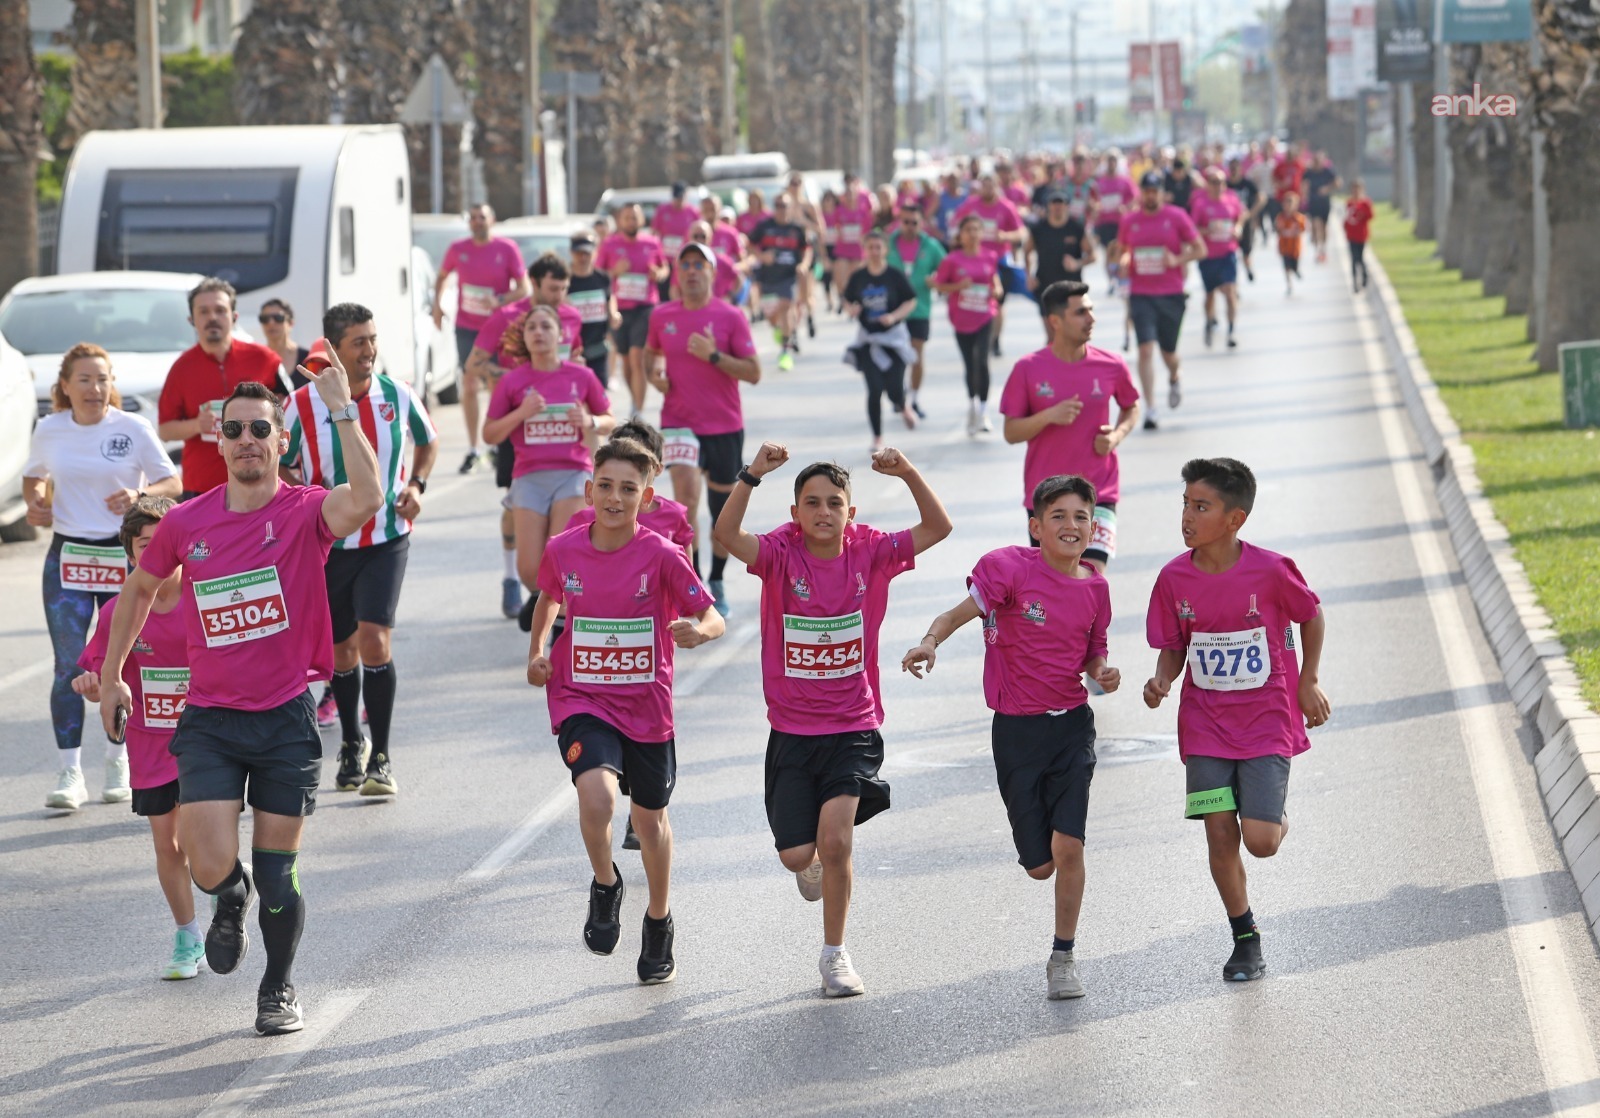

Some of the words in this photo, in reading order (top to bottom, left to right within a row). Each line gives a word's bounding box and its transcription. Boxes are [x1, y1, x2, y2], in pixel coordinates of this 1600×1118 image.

[67, 566, 122, 582] 35174
[205, 579, 240, 593] KARŞIYAKA
[239, 571, 275, 585] BELEDİYESİ
[206, 601, 280, 633] 35104
[585, 623, 618, 631] KARŞIYAKA
[618, 622, 651, 631] BELEDİYESİ
[797, 622, 830, 630] KARŞIYAKA
[830, 617, 861, 628] BELEDİYESİ
[576, 651, 650, 670] 35456
[788, 644, 861, 667] 35454
[1196, 645, 1263, 676] 1278
